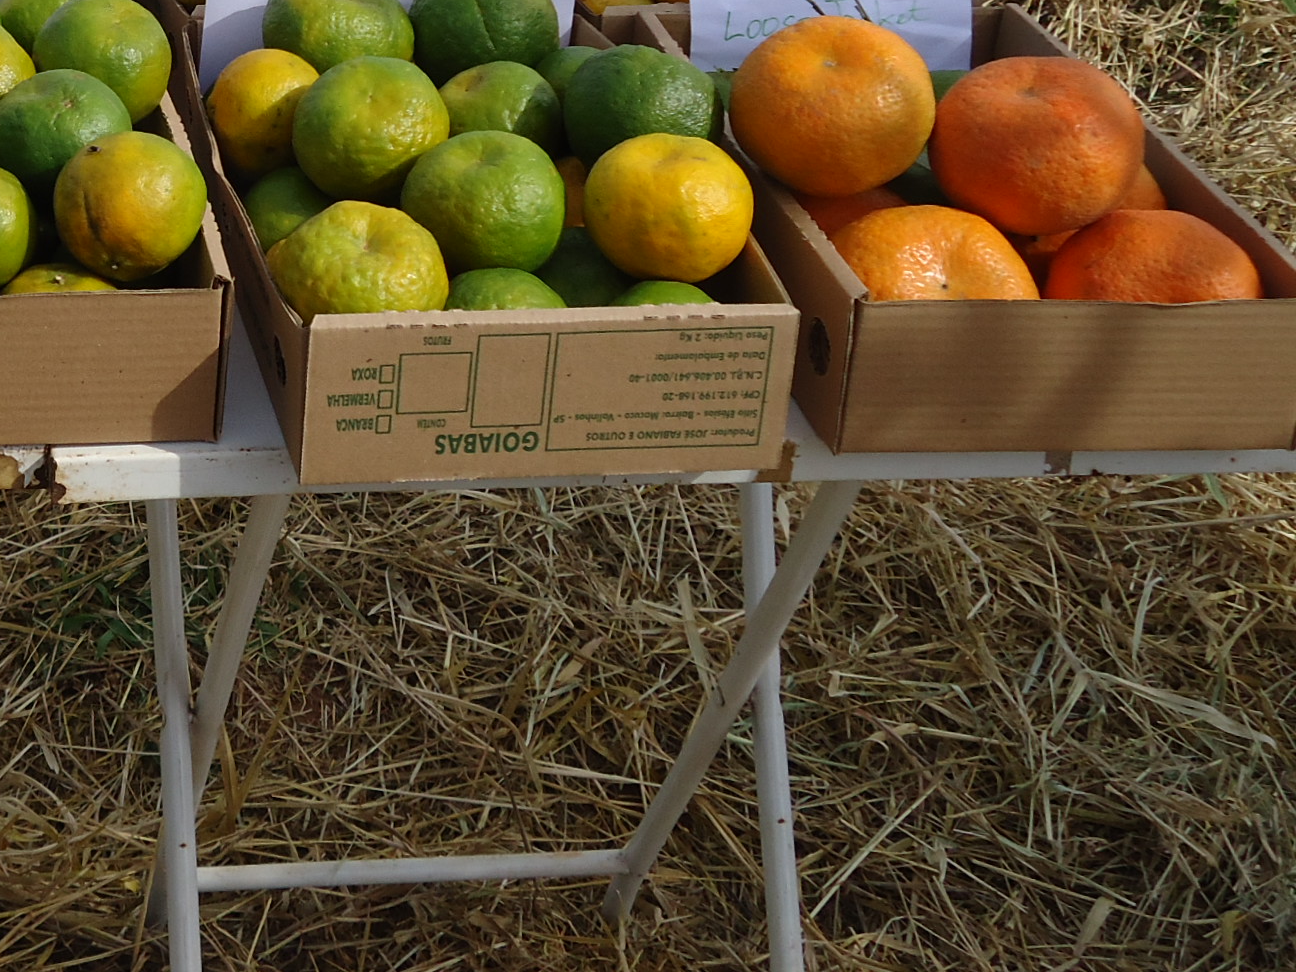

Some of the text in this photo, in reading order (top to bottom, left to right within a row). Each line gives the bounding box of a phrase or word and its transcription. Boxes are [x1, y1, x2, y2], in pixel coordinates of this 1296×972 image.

[423, 336, 451, 345] FRUTOS
[680, 333, 692, 342] Kg
[747, 332, 767, 340] Peso
[728, 352, 739, 361] de
[351, 368, 377, 380] ROXA
[327, 393, 375, 406] VERMELHA
[662, 392, 737, 401] 612.199.168-20
[553, 415, 565, 423] SP
[575, 413, 613, 421] Valinhos
[336, 418, 374, 431] BRANCA
[586, 432, 625, 441] OUTROS
[637, 431, 681, 439] FABIANO
[711, 429, 755, 437] Produtor:
[435, 432, 539, 455] GOIABAS
